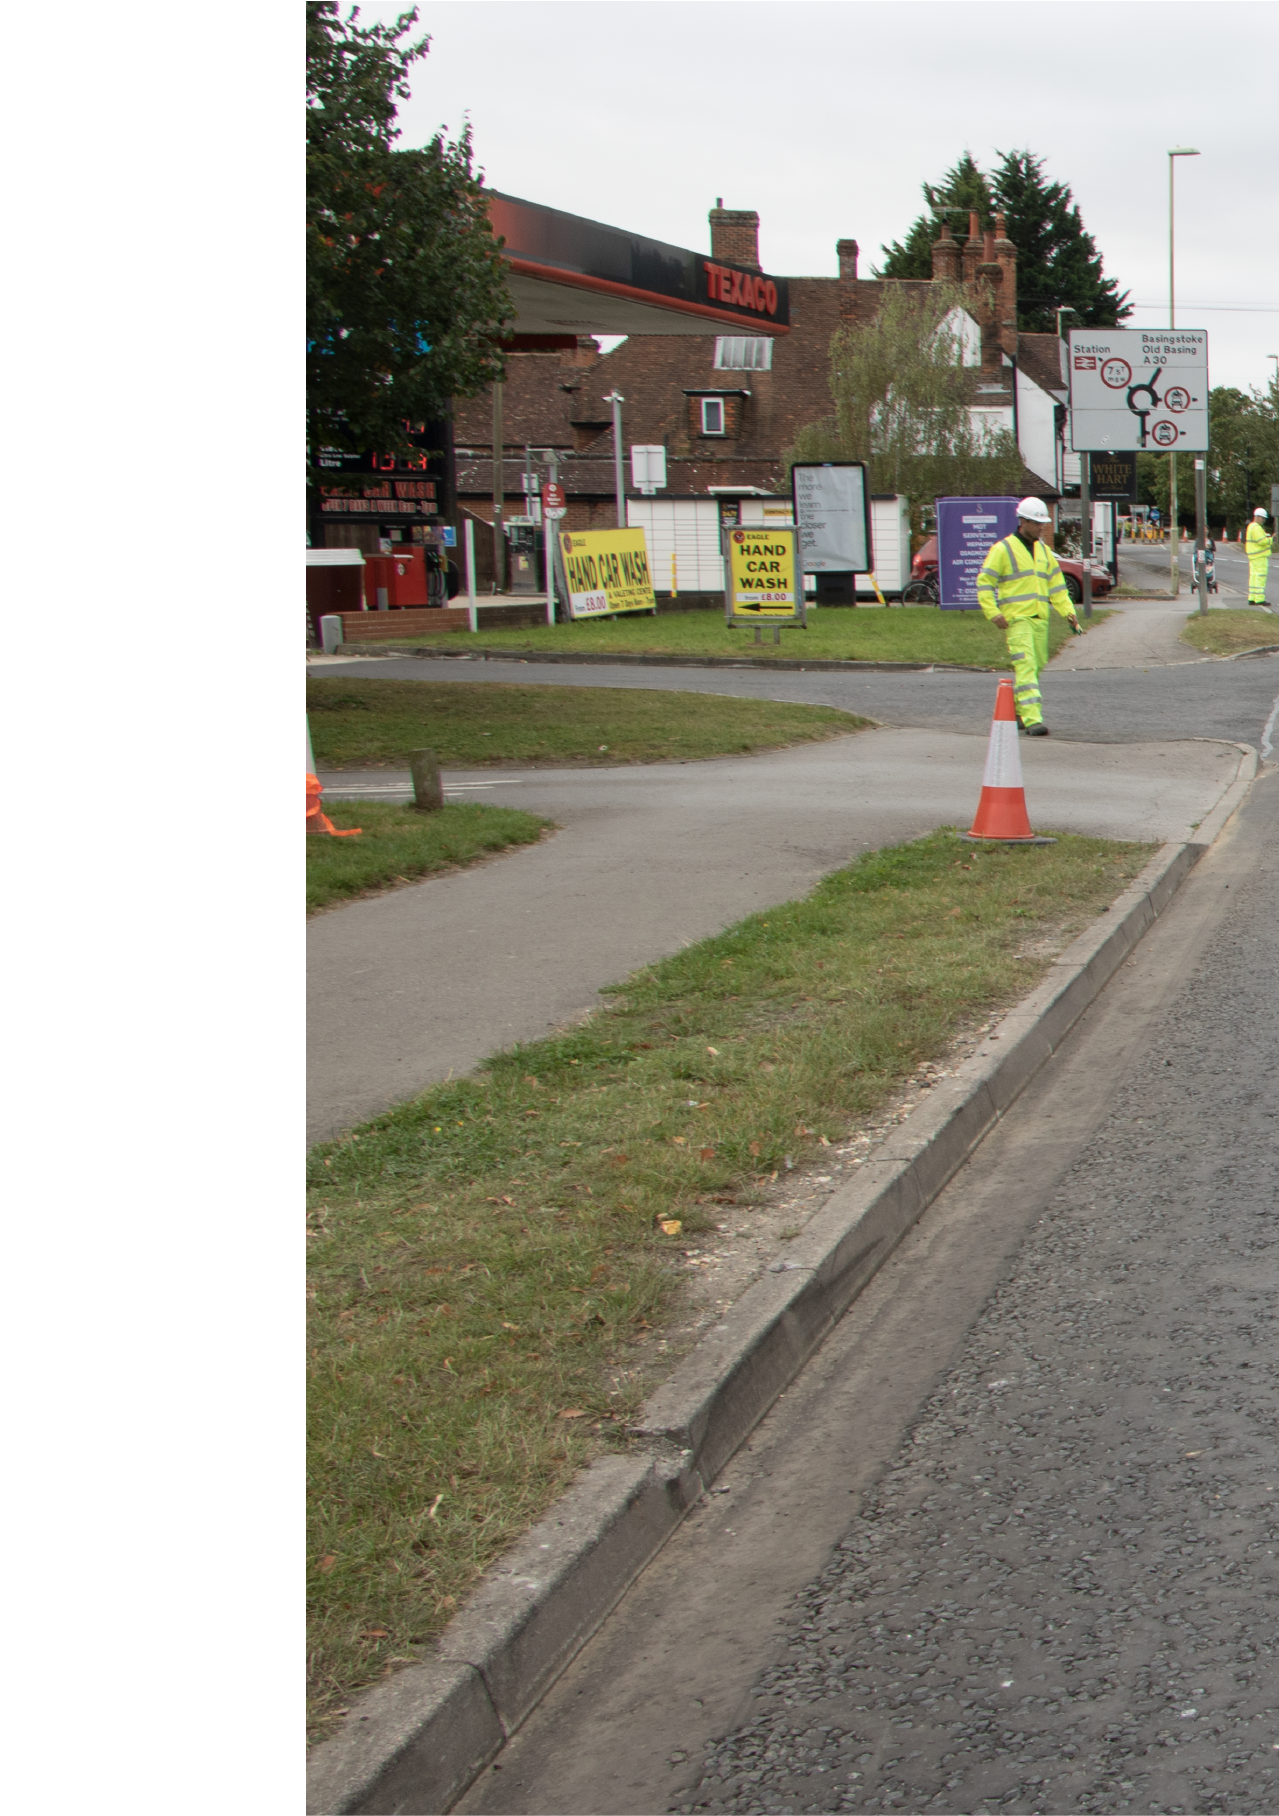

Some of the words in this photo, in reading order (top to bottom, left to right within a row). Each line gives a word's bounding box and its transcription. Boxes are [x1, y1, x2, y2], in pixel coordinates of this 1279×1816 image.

[703, 261, 778, 316] TEXACO
[1142, 334, 1203, 344] Basingstoke
[1074, 345, 1111, 354] Station
[1142, 345, 1161, 354] Old
[1163, 345, 1197, 355] Basing
[319, 458, 342, 467] Litre
[1092, 464, 1132, 474] WHITE
[798, 473, 814, 482] The
[1096, 474, 1129, 484] HART
[394, 481, 438, 499] WASH
[800, 521, 827, 529] closer
[801, 540, 818, 549] get.
[739, 545, 787, 556] HAND
[746, 561, 780, 573] CAR
[802, 560, 826, 568] Google
[565, 555, 598, 593] HAND
[598, 553, 622, 590] CAR
[620, 551, 651, 587] WASH
[739, 578, 788, 589] WASH
[761, 593, 787, 601] £8.00
[586, 596, 607, 611] £8.00
